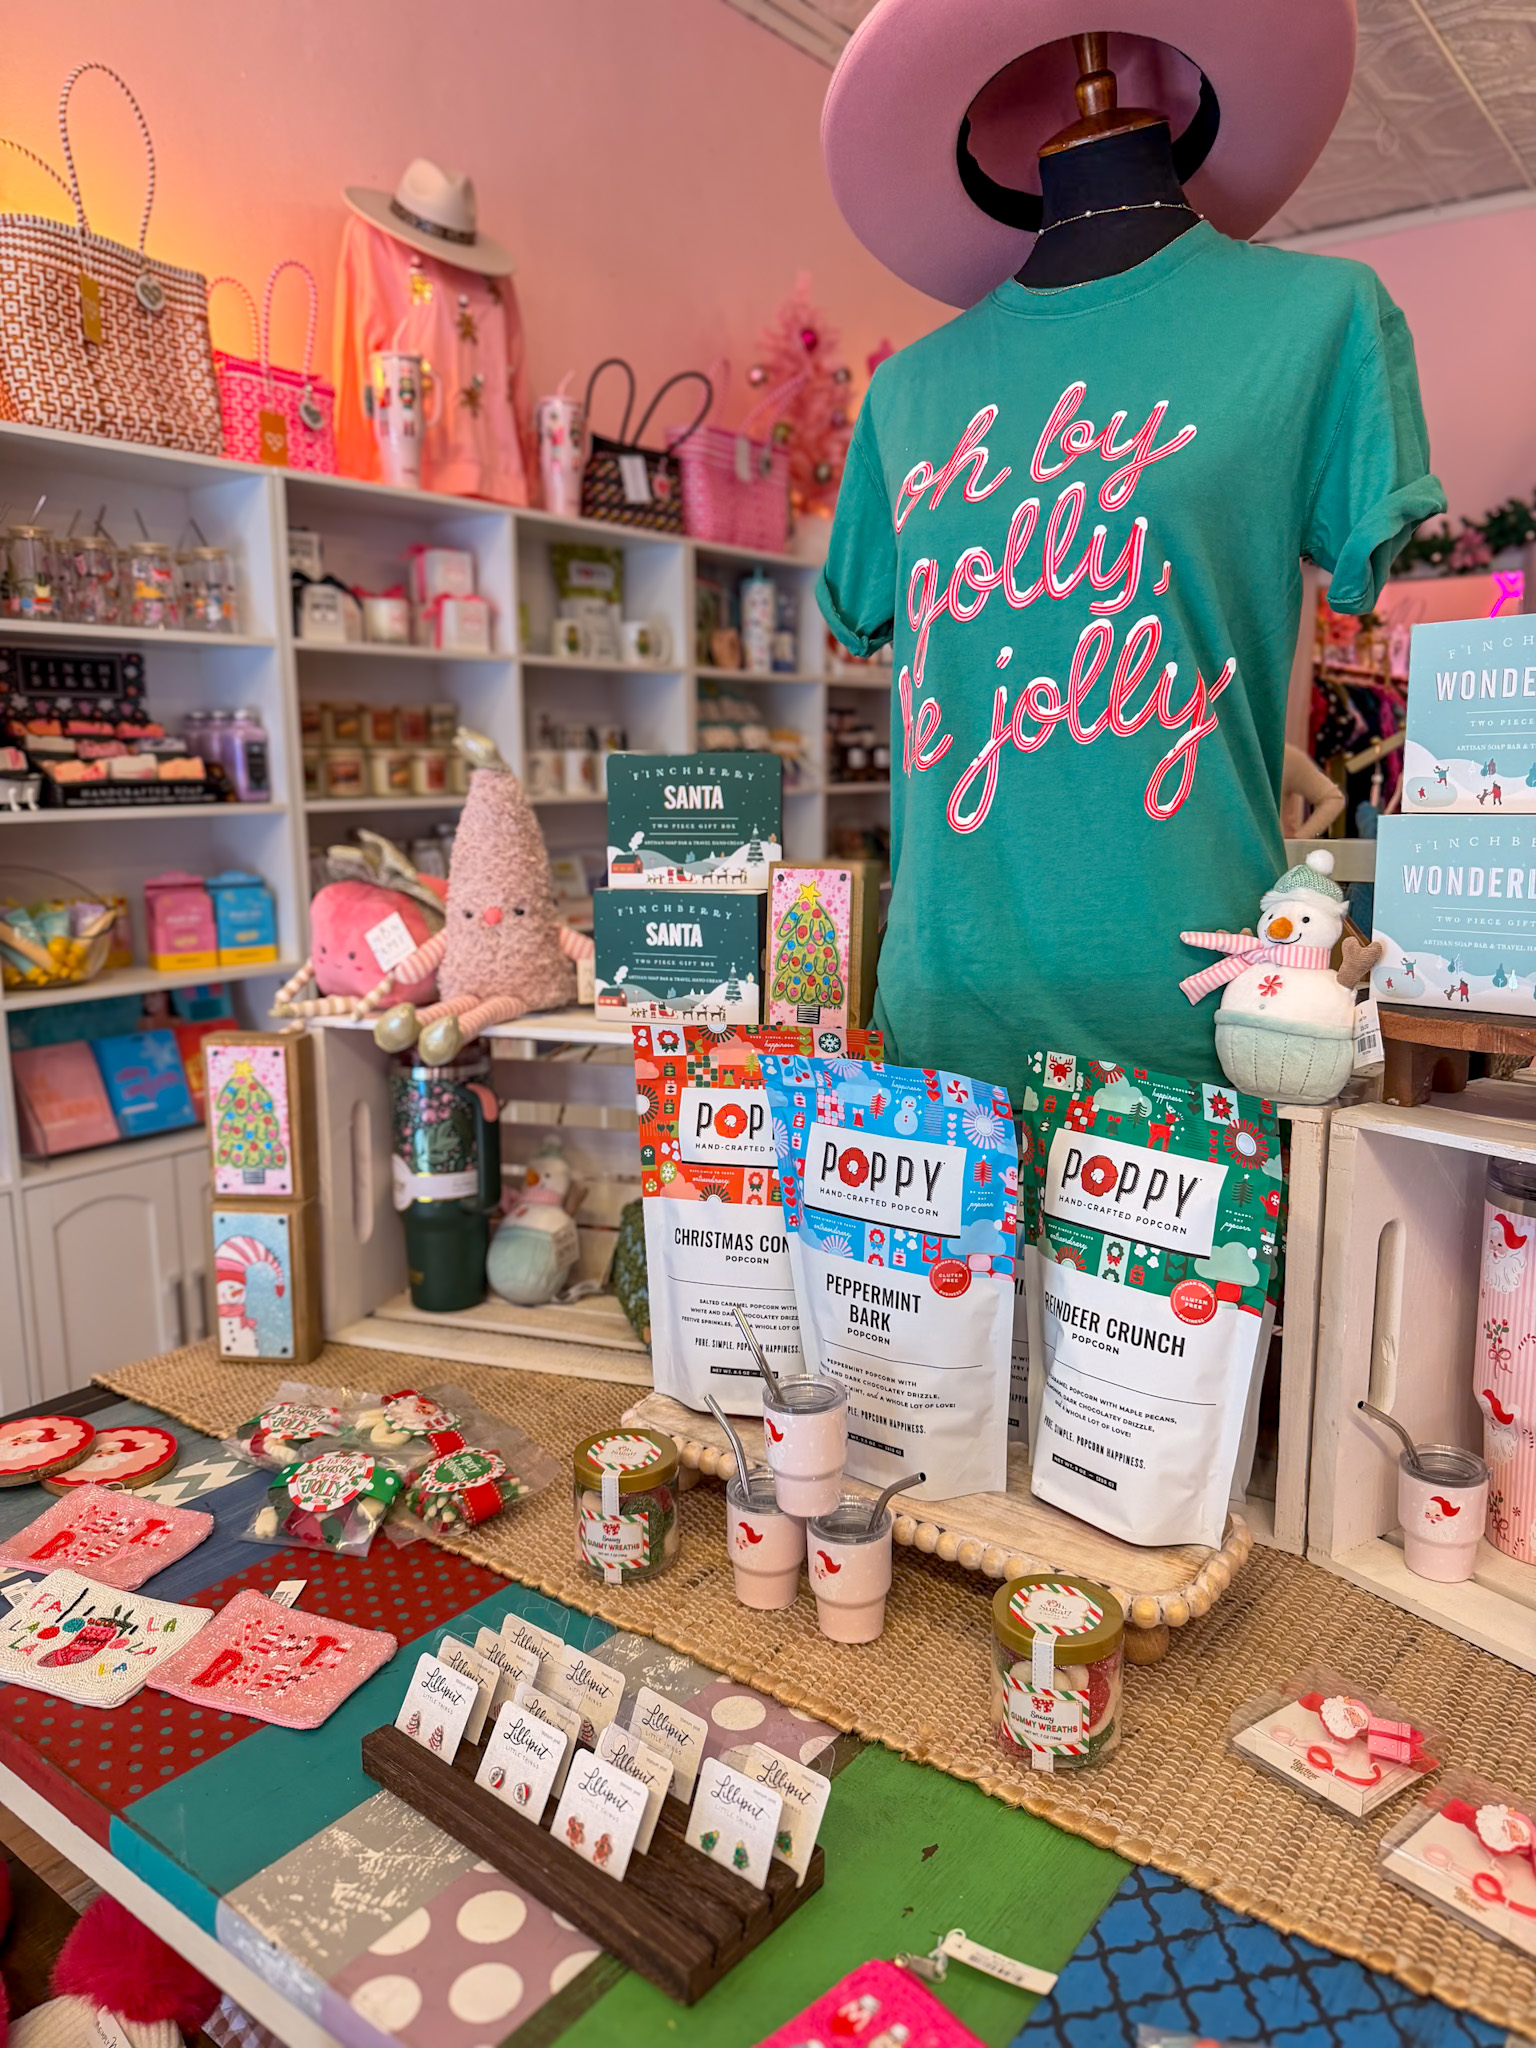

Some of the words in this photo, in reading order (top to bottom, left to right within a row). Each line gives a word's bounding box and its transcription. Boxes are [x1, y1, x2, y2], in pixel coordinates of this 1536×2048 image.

[895, 403, 1012, 534] oh
[1030, 381, 1197, 512] by
[907, 481, 1172, 688] golly,
[1449, 635, 1534, 659] FINCH
[29, 660, 112, 677] FINCH
[899, 665, 953, 778] be
[947, 615, 1237, 835] jolly
[1500, 718, 1534, 726] PIECE
[633, 767, 754, 781] FINCHBERRY
[81, 786, 168, 798] HANDCRAFTED
[664, 785, 724, 810] SANTA
[617, 904, 732, 919] FINCHBERRY
[1467, 917, 1501, 926] PIECE
[646, 922, 703, 948] SANTA
[1424, 939, 1453, 947] ARTISAN
[1497, 943, 1525, 951] TRAVEL
[1152, 1088, 1183, 1104] happiness
[695, 1143, 765, 1152] HAND-CRAFTED
[820, 1141, 946, 1203] POPPY
[1060, 1147, 1202, 1219] POPPY
[819, 1187, 887, 1208] HAND-CRAFTED
[891, 1202, 939, 1217] POPCORN
[1058, 1195, 1132, 1220] HAND-CRAFTED
[1136, 1216, 1187, 1236] POPCORN
[1220, 1221, 1251, 1233] popcorn
[675, 1228, 753, 1251] CHRISTMAS
[725, 1256, 769, 1264] POPCORN
[826, 1273, 922, 1314] PEPPERMINT
[1181, 1296, 1208, 1305] GLUTEN
[1185, 1302, 1202, 1310] FREE
[701, 1319, 733, 1327] SPRINKLES,
[850, 1304, 891, 1333] BARK
[1045, 1291, 1101, 1334] REINDEER
[1106, 1317, 1186, 1358] CRUNCH
[695, 1338, 710, 1347] PURE.
[712, 1340, 734, 1349] SIMPLE.
[766, 1344, 800, 1353] HAPPINESS.
[847, 1327, 891, 1346] POPCORN
[1072, 1332, 1120, 1355] POPCORN
[827, 1358, 863, 1374] PEPPERMINT
[865, 1370, 896, 1383] POPCORN
[898, 1379, 917, 1387] WITH
[831, 1369, 843, 1378] AND
[845, 1374, 861, 1383] DARK
[863, 1380, 905, 1395] CHOCOLATEY
[907, 1391, 940, 1399] DRIZZLE,
[885, 1398, 909, 1408] WHOLE
[1063, 1395, 1078, 1406] DARK
[1078, 1403, 1121, 1422] CHOCOLATEY
[1123, 1419, 1155, 1432] DRIZZLE,
[1069, 1386, 1098, 1402] POPCORN
[1100, 1399, 1118, 1409] WITH
[1119, 1406, 1143, 1418] MAPLE
[1145, 1413, 1177, 1424] PECANS,
[861, 1410, 887, 1426] POPCORN
[889, 1419, 926, 1434] HAPPINESS.
[1065, 1407, 1086, 1421] WHOLE
[1088, 1417, 1100, 1426] LOT
[1111, 1427, 1132, 1438] LOVE!
[1054, 1424, 1074, 1442] SIMPLE.
[1077, 1435, 1104, 1455] POPCORN
[1106, 1448, 1146, 1469] HAPPINESS.
[301, 1479, 349, 1499] JOLLY
[30, 1593, 62, 1614] FA
[147, 1616, 177, 1633] LA
[421, 1667, 467, 1707] Lilliput
[566, 1660, 615, 1699] Lilliput
[641, 1704, 695, 1747] Lilliput
[1011, 1711, 1036, 1728] GUMMY
[1038, 1723, 1078, 1733] WREATHS
[503, 1717, 554, 1761] Lilliput
[578, 1767, 634, 1813] Lilliput
[756, 1760, 818, 1805] Lilliput
[710, 1775, 771, 1821] Lilliput
